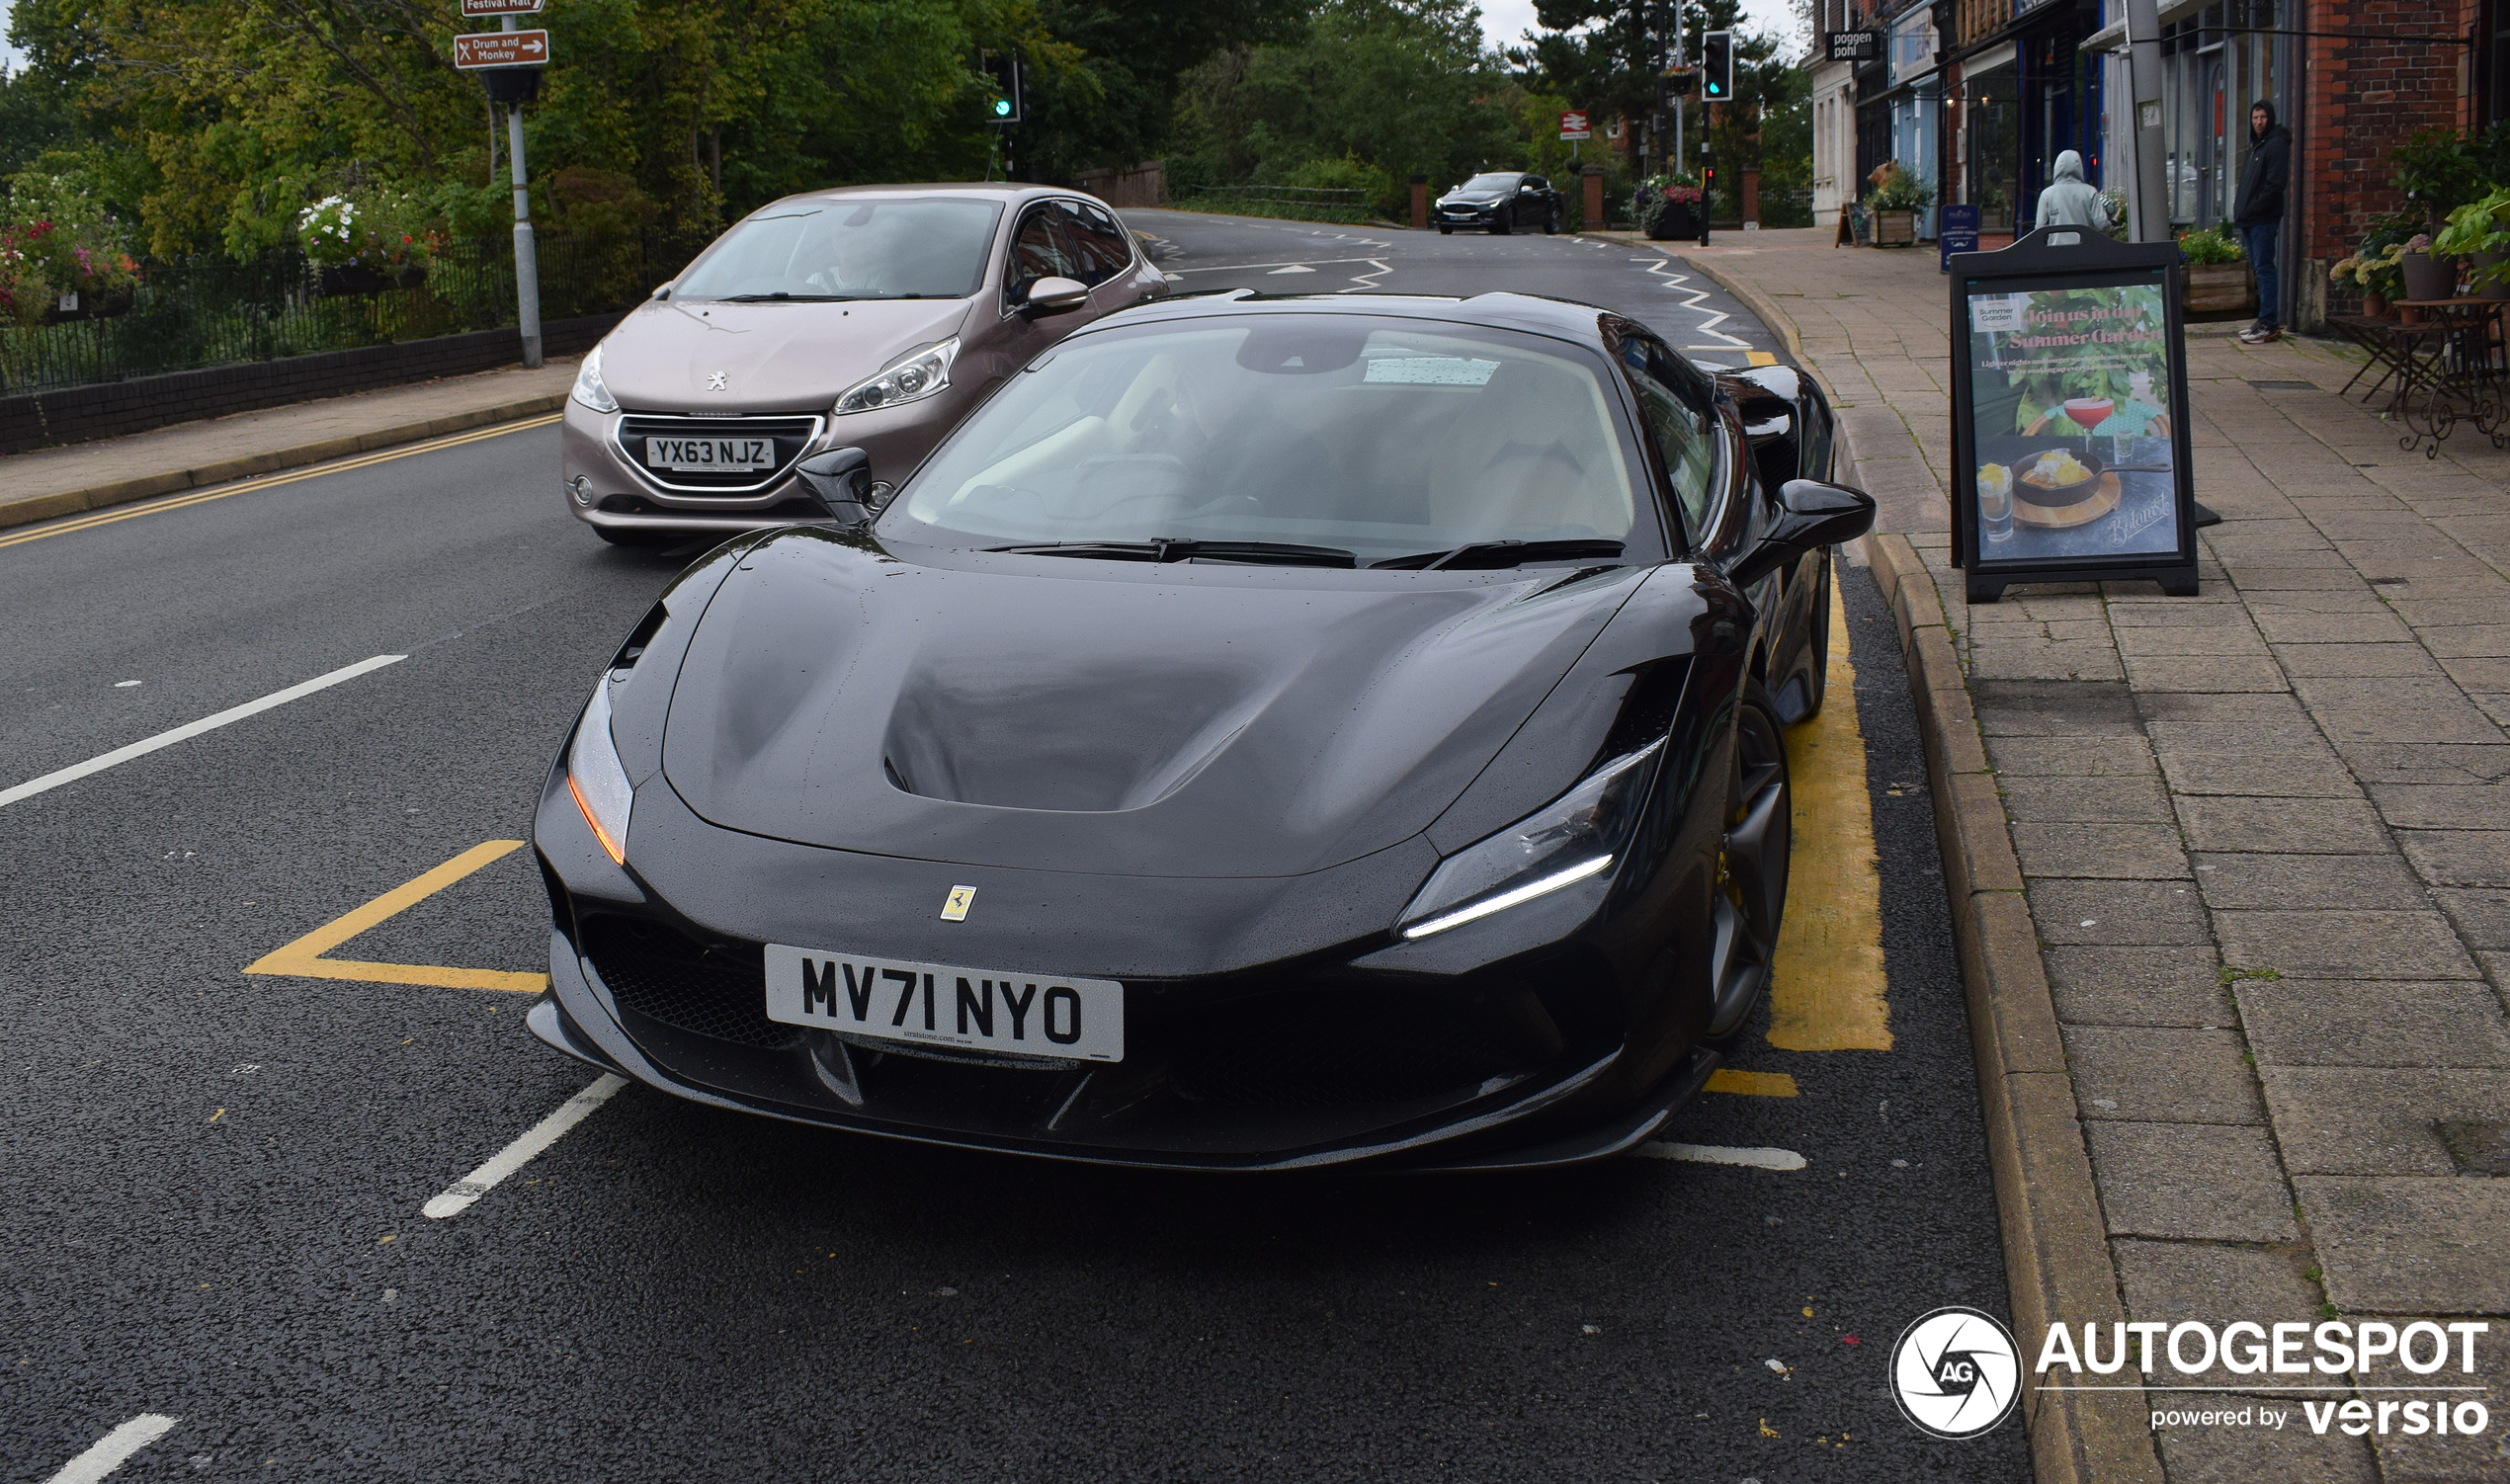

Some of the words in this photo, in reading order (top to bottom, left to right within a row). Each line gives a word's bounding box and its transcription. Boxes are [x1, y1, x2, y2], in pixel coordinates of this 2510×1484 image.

[467, 0, 506, 9] Festival
[472, 40, 498, 49] Drum
[502, 37, 519, 47] and
[1834, 33, 1872, 45] poggen
[478, 49, 515, 60] Monkey
[1834, 44, 1857, 58] pohl
[2025, 308, 2065, 324] Join
[2067, 310, 2089, 321] us
[2091, 306, 2110, 320] in
[2112, 307, 2143, 319] our
[2010, 333, 2089, 349] Summer
[2091, 327, 2162, 343] Garden
[2009, 358, 2031, 367] nights
[656, 441, 713, 463] YX63
[719, 442, 765, 463] NJZ
[801, 957, 936, 1031] MV71
[956, 976, 1082, 1045] NYO
[903, 1031, 955, 1042] stratstone.com
